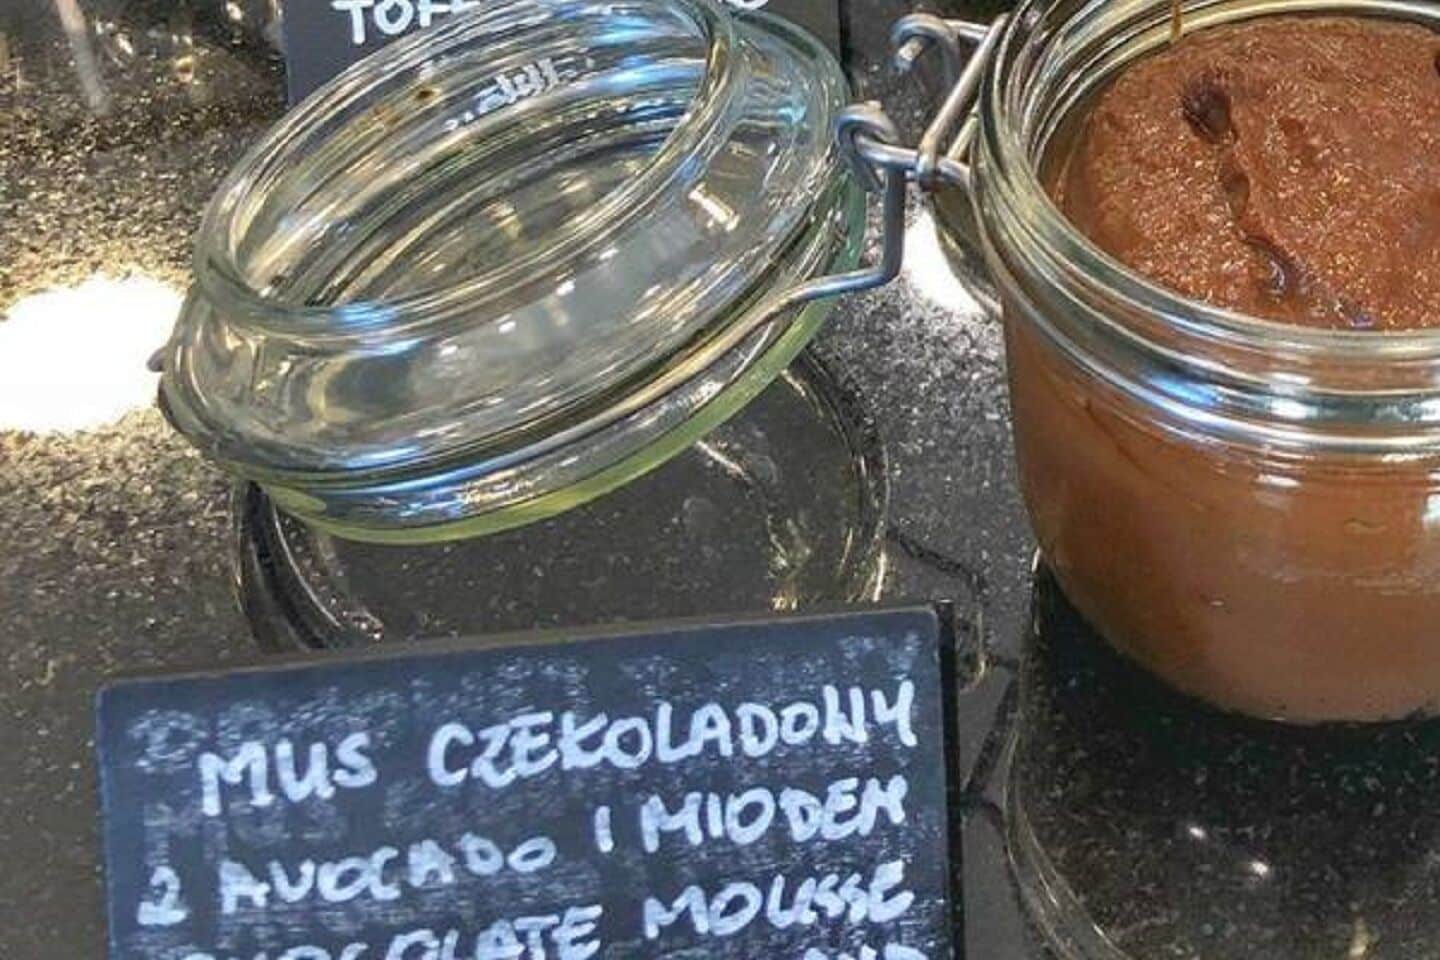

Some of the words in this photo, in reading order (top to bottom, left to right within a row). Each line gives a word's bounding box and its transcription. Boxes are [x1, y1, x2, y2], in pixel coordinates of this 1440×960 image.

[199, 732, 379, 816] MUS
[217, 831, 557, 915] AVOCADO
[640, 773, 909, 853] MIODEM
[643, 858, 915, 938] MOUSSE
